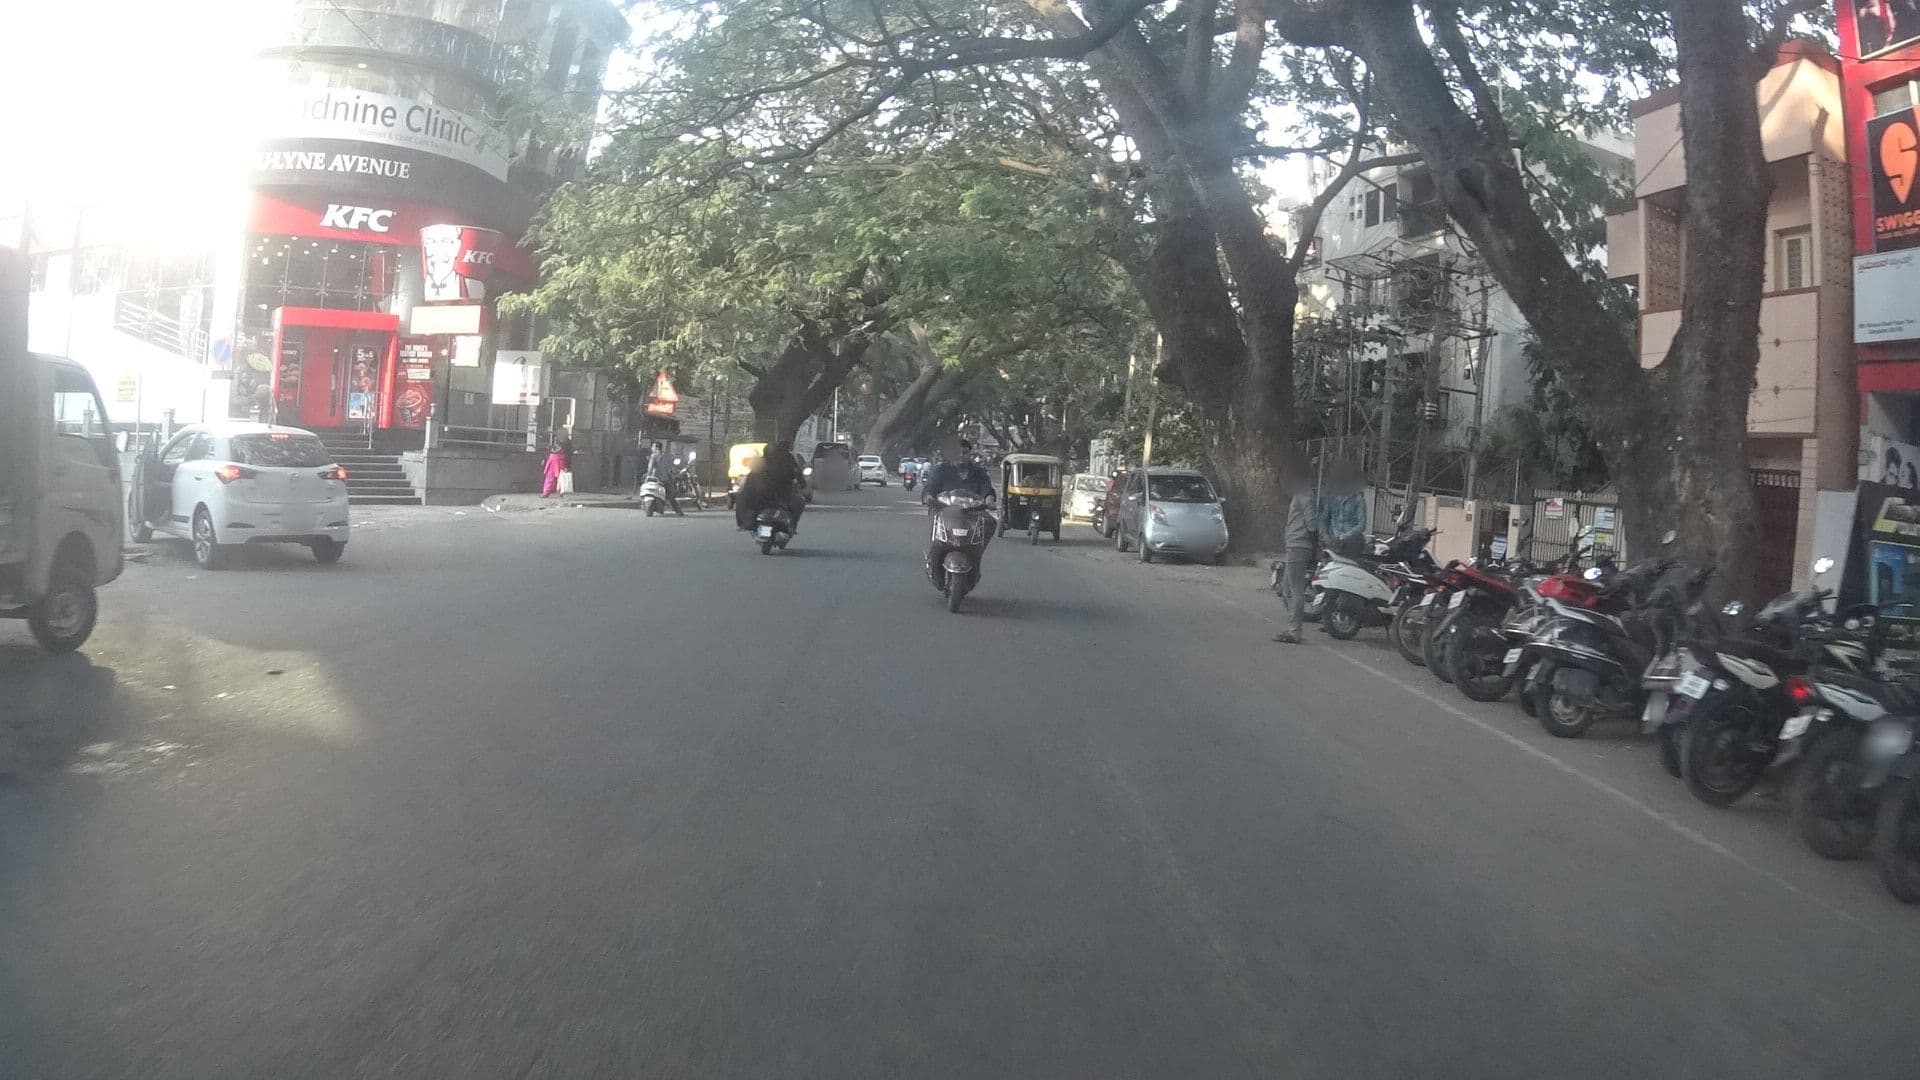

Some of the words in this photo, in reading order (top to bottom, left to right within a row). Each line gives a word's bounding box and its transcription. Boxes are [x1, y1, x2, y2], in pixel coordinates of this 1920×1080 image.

[406, 103, 473, 146] Clinic
[328, 153, 411, 179] AVENUE
[320, 203, 394, 233] KFC
[462, 249, 494, 265] KFC
